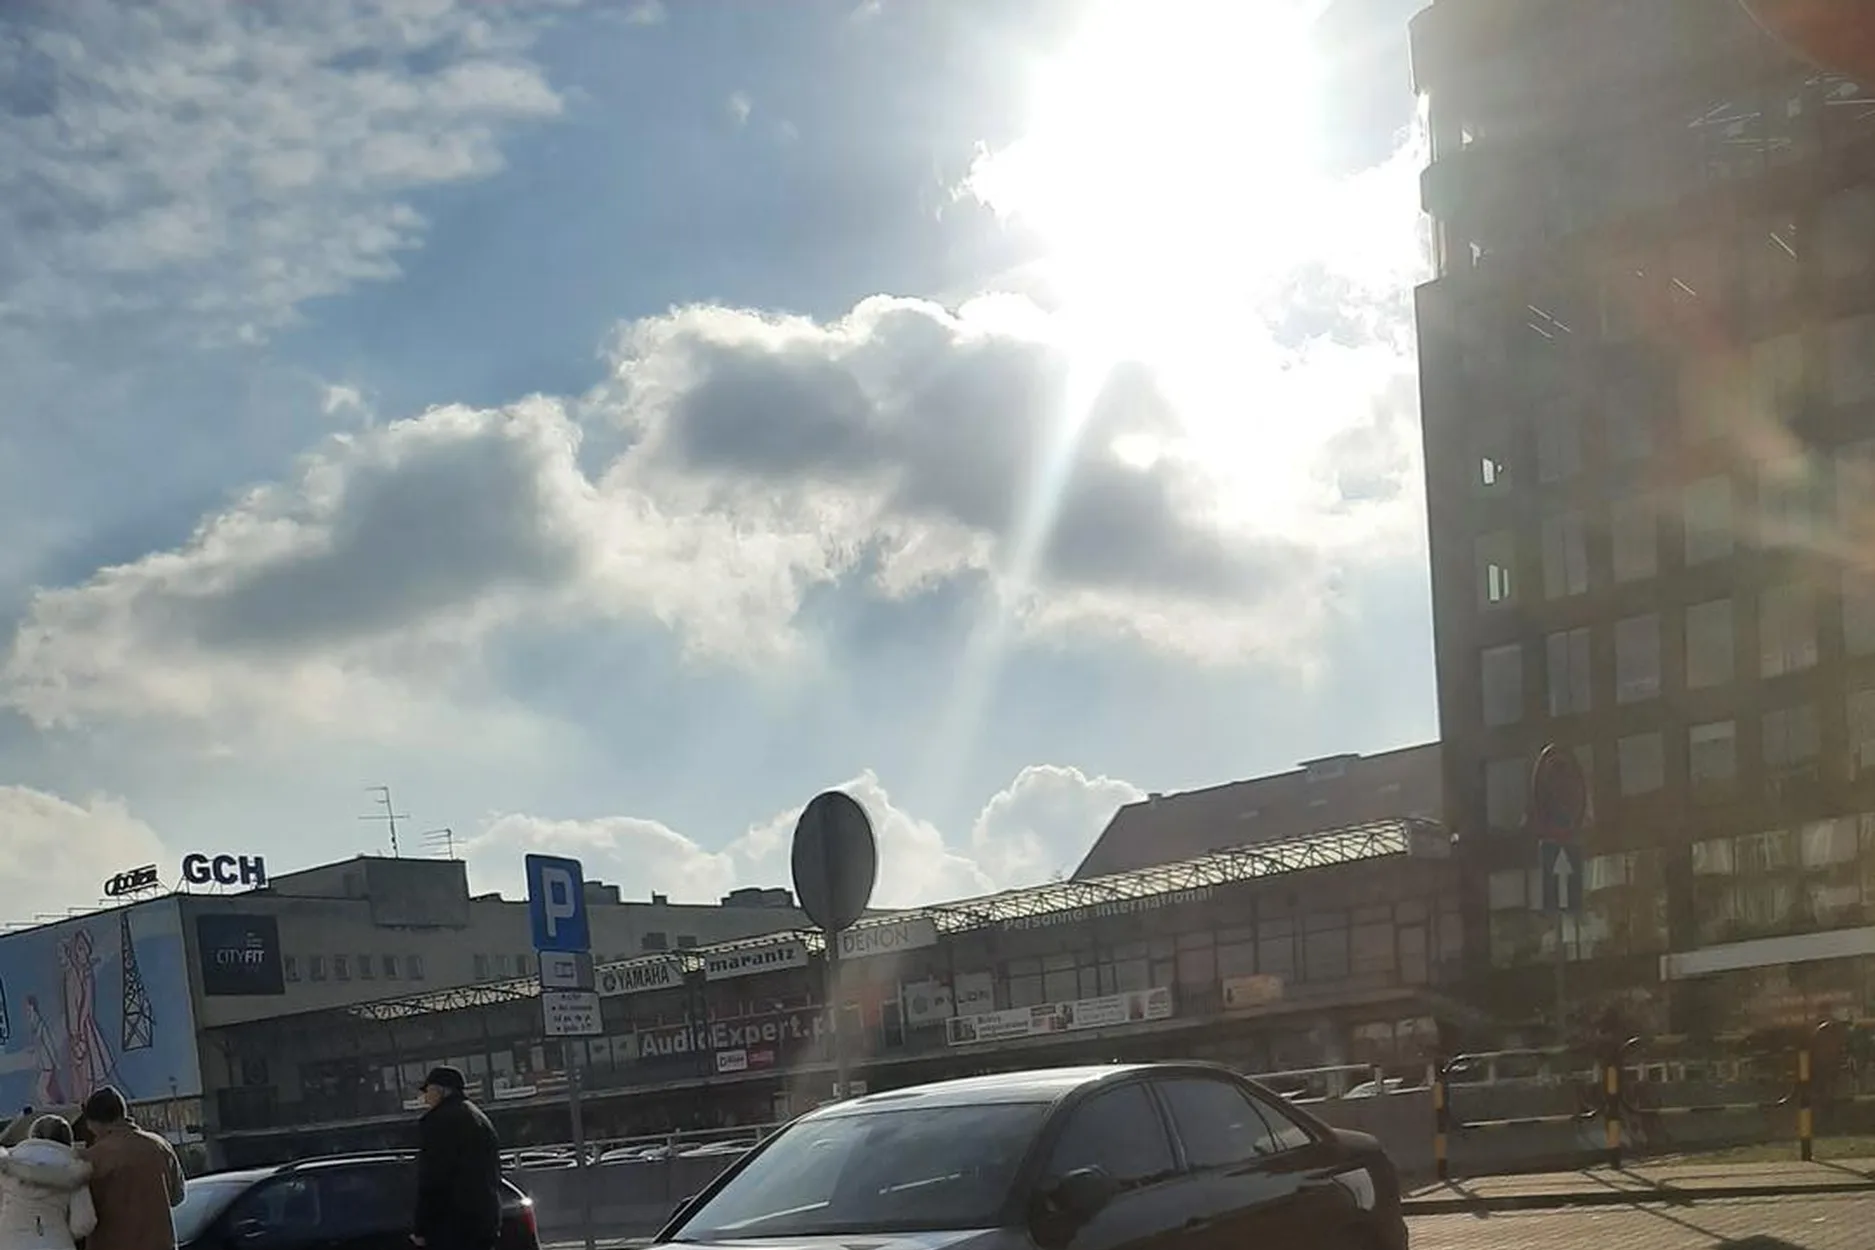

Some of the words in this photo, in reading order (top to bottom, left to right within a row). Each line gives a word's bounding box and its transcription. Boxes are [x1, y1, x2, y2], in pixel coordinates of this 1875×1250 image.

[182, 853, 267, 886] GCH
[541, 867, 576, 937] P
[843, 926, 909, 953] DENON
[216, 949, 265, 964] CITYFIT
[709, 947, 797, 974] marantz
[618, 964, 670, 990] YAMAHA
